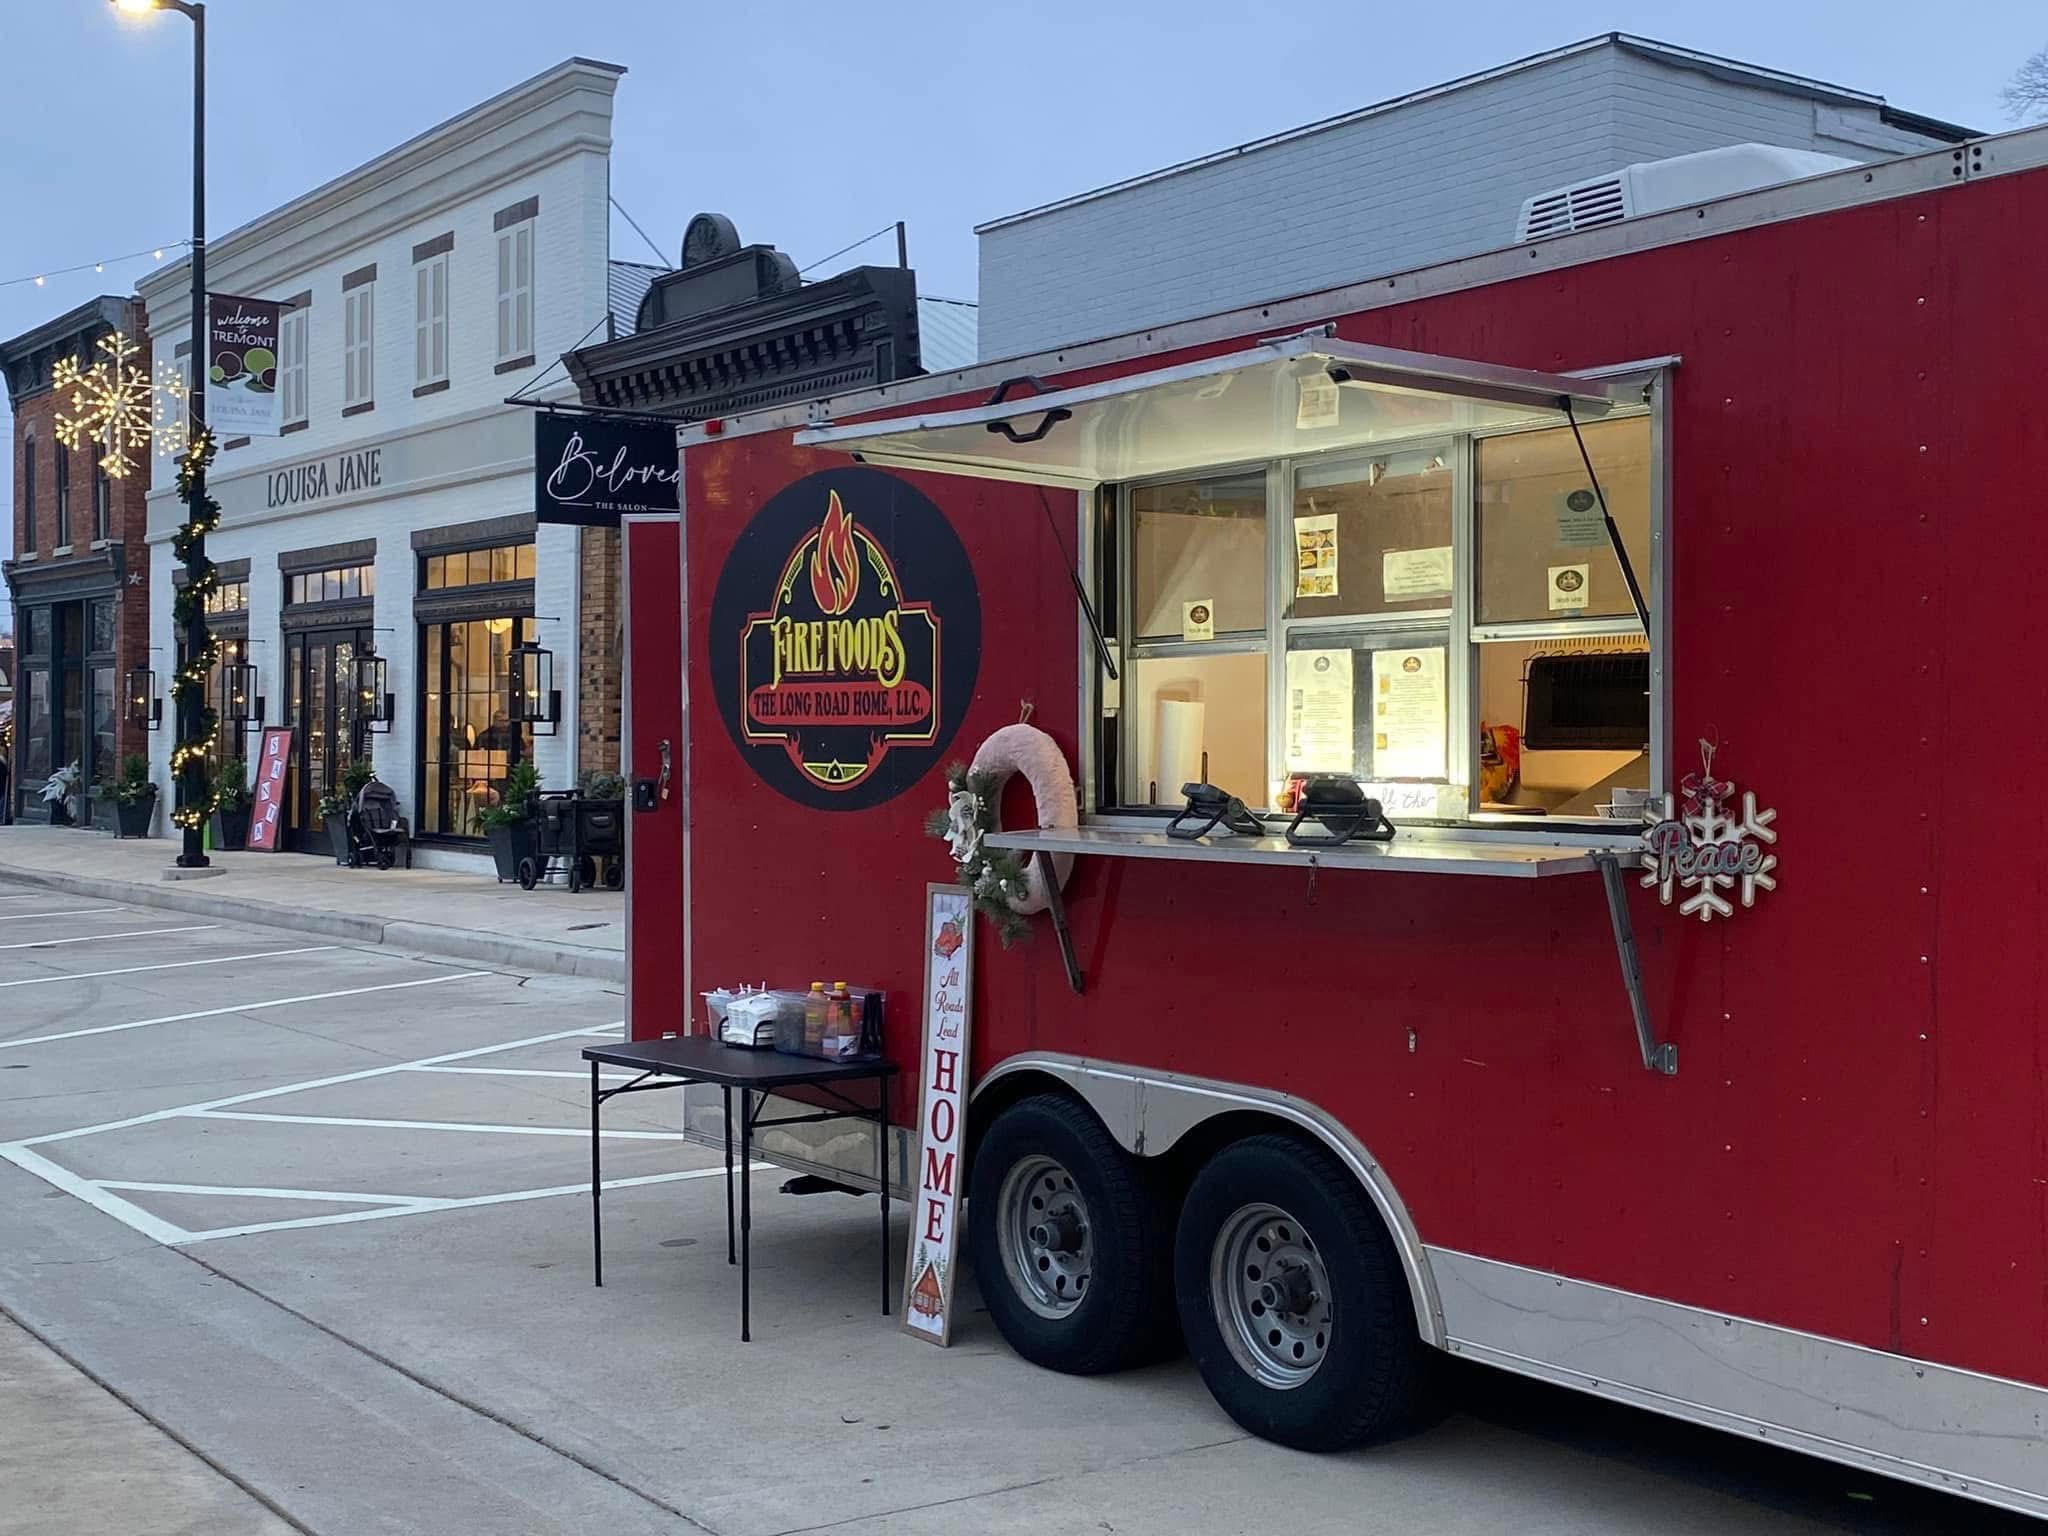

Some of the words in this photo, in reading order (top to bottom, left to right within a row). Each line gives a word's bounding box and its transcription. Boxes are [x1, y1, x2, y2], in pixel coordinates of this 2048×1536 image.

[217, 304, 270, 327] welcome
[212, 329, 275, 348] TREMONT
[268, 462, 329, 508] LOUISA
[335, 449, 381, 494] JANE
[595, 501, 614, 511] THE
[616, 503, 648, 512] SALON
[826, 610, 906, 688] FOODS
[755, 693, 777, 717] THE
[779, 692, 812, 717] LONG
[815, 692, 849, 717] ROAD
[853, 690, 893, 720] HOME,
[896, 690, 924, 716] LLC.
[1652, 820, 1764, 883] Peace
[940, 967, 959, 988] All
[935, 990, 964, 1015] Roads
[936, 1016, 958, 1041] Lead
[923, 1048, 959, 1244] HOME
